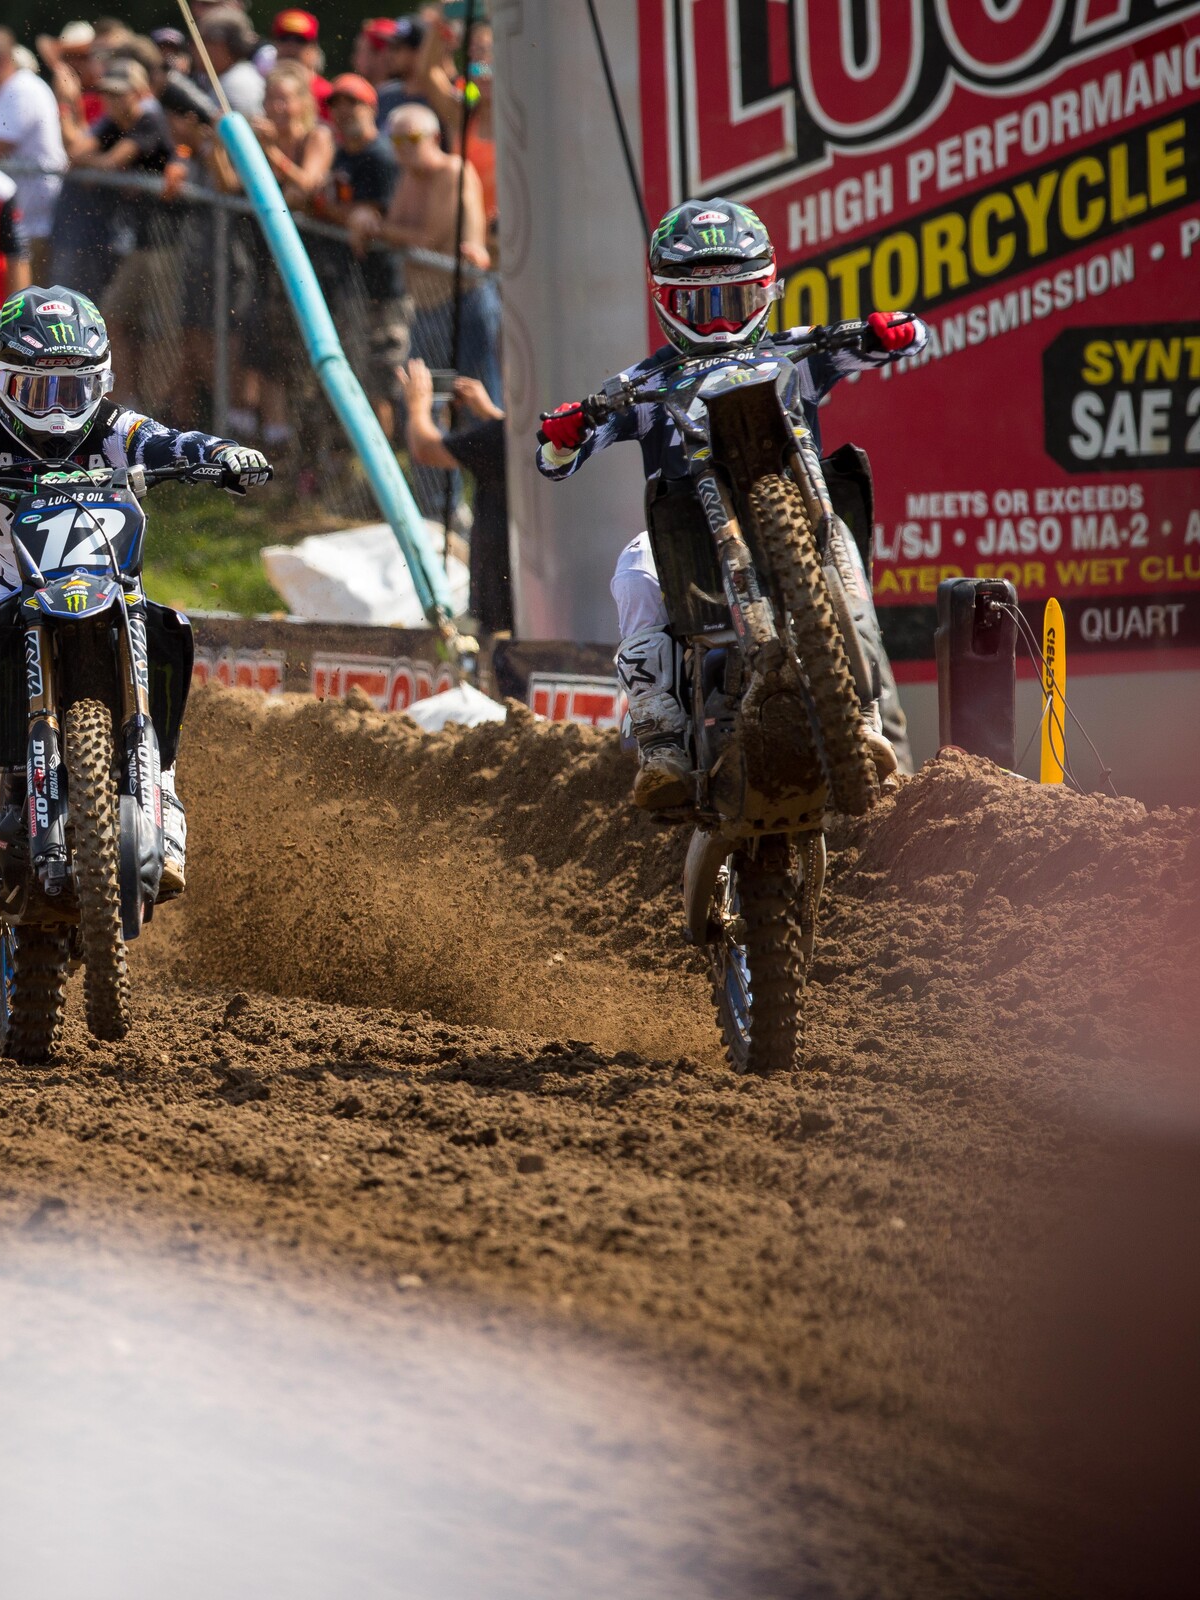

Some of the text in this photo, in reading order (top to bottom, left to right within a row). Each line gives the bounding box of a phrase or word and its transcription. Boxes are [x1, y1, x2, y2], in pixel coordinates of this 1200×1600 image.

[788, 163, 893, 251] HIGH
[766, 118, 1188, 338] OTORCYCLE
[42, 303, 68, 312] BELL
[880, 244, 1134, 381] ANSMISSION
[44, 345, 90, 354] MONSTER
[1069, 388, 1172, 461] SAE
[192, 467, 222, 476] ARC
[48, 493, 84, 507] LUCAS
[86, 492, 104, 502] OIL
[907, 483, 1144, 519] MEETS OR EXCEEDS
[36, 507, 126, 572] 12
[977, 517, 1062, 555] JASO
[872, 563, 965, 595] ATED
[1056, 558, 1130, 587] WET
[1080, 603, 1185, 642] QUART
[33, 739, 49, 829] DULOP
[49, 768, 60, 800] CYCRA
